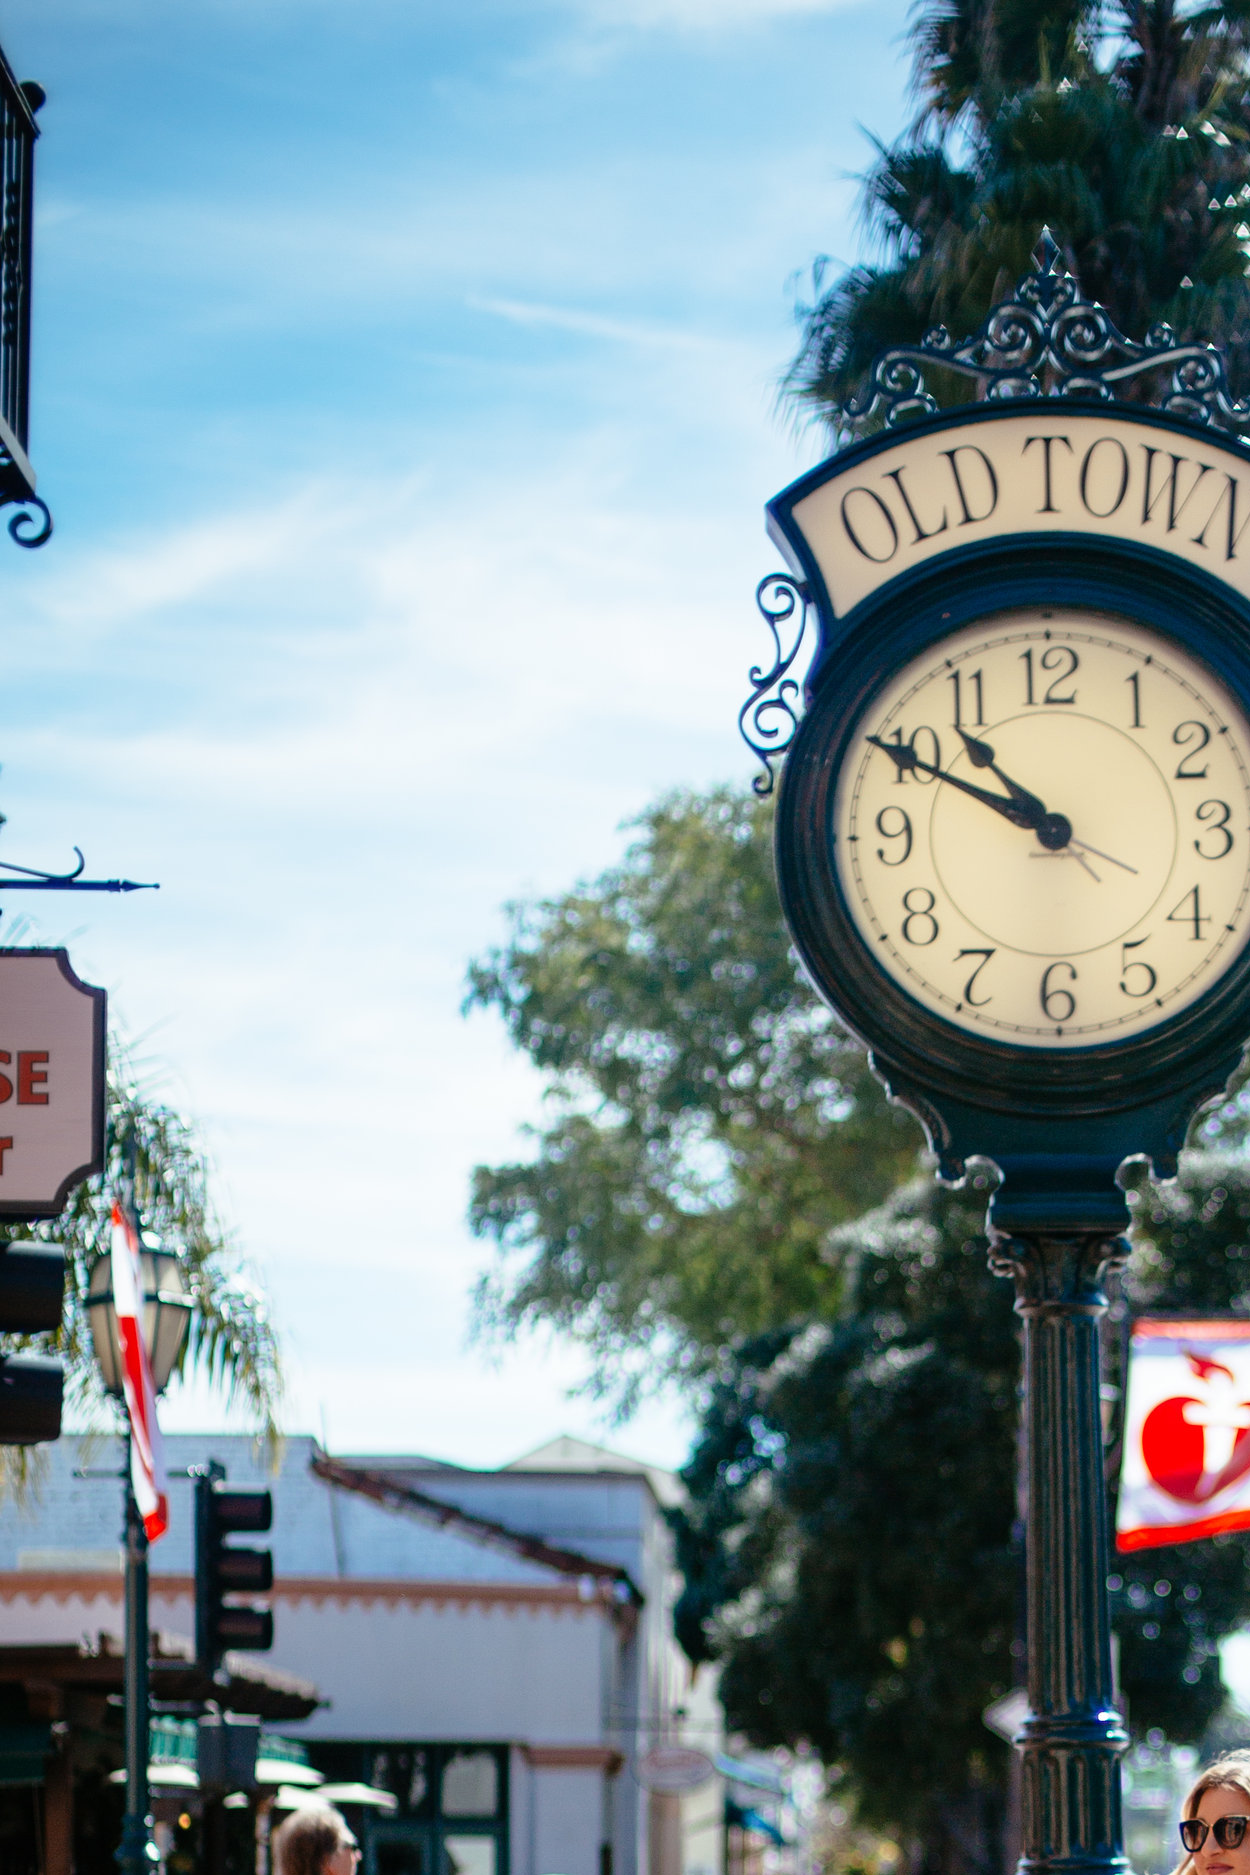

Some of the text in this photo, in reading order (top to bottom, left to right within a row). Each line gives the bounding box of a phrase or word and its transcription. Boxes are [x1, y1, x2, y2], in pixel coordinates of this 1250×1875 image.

[841, 445, 999, 564] OLD
[947, 668, 988, 727] 11
[1018, 646, 1080, 705] 12
[1125, 670, 1145, 728] 1
[889, 726, 941, 784] 10
[1172, 721, 1210, 779] 2
[876, 806, 913, 866] 9
[1194, 799, 1234, 860] 3
[901, 887, 939, 945] 8
[1166, 883, 1211, 940] 4
[952, 949, 996, 1006] 7
[1040, 961, 1077, 1021] 6
[1119, 933, 1157, 998] 5
